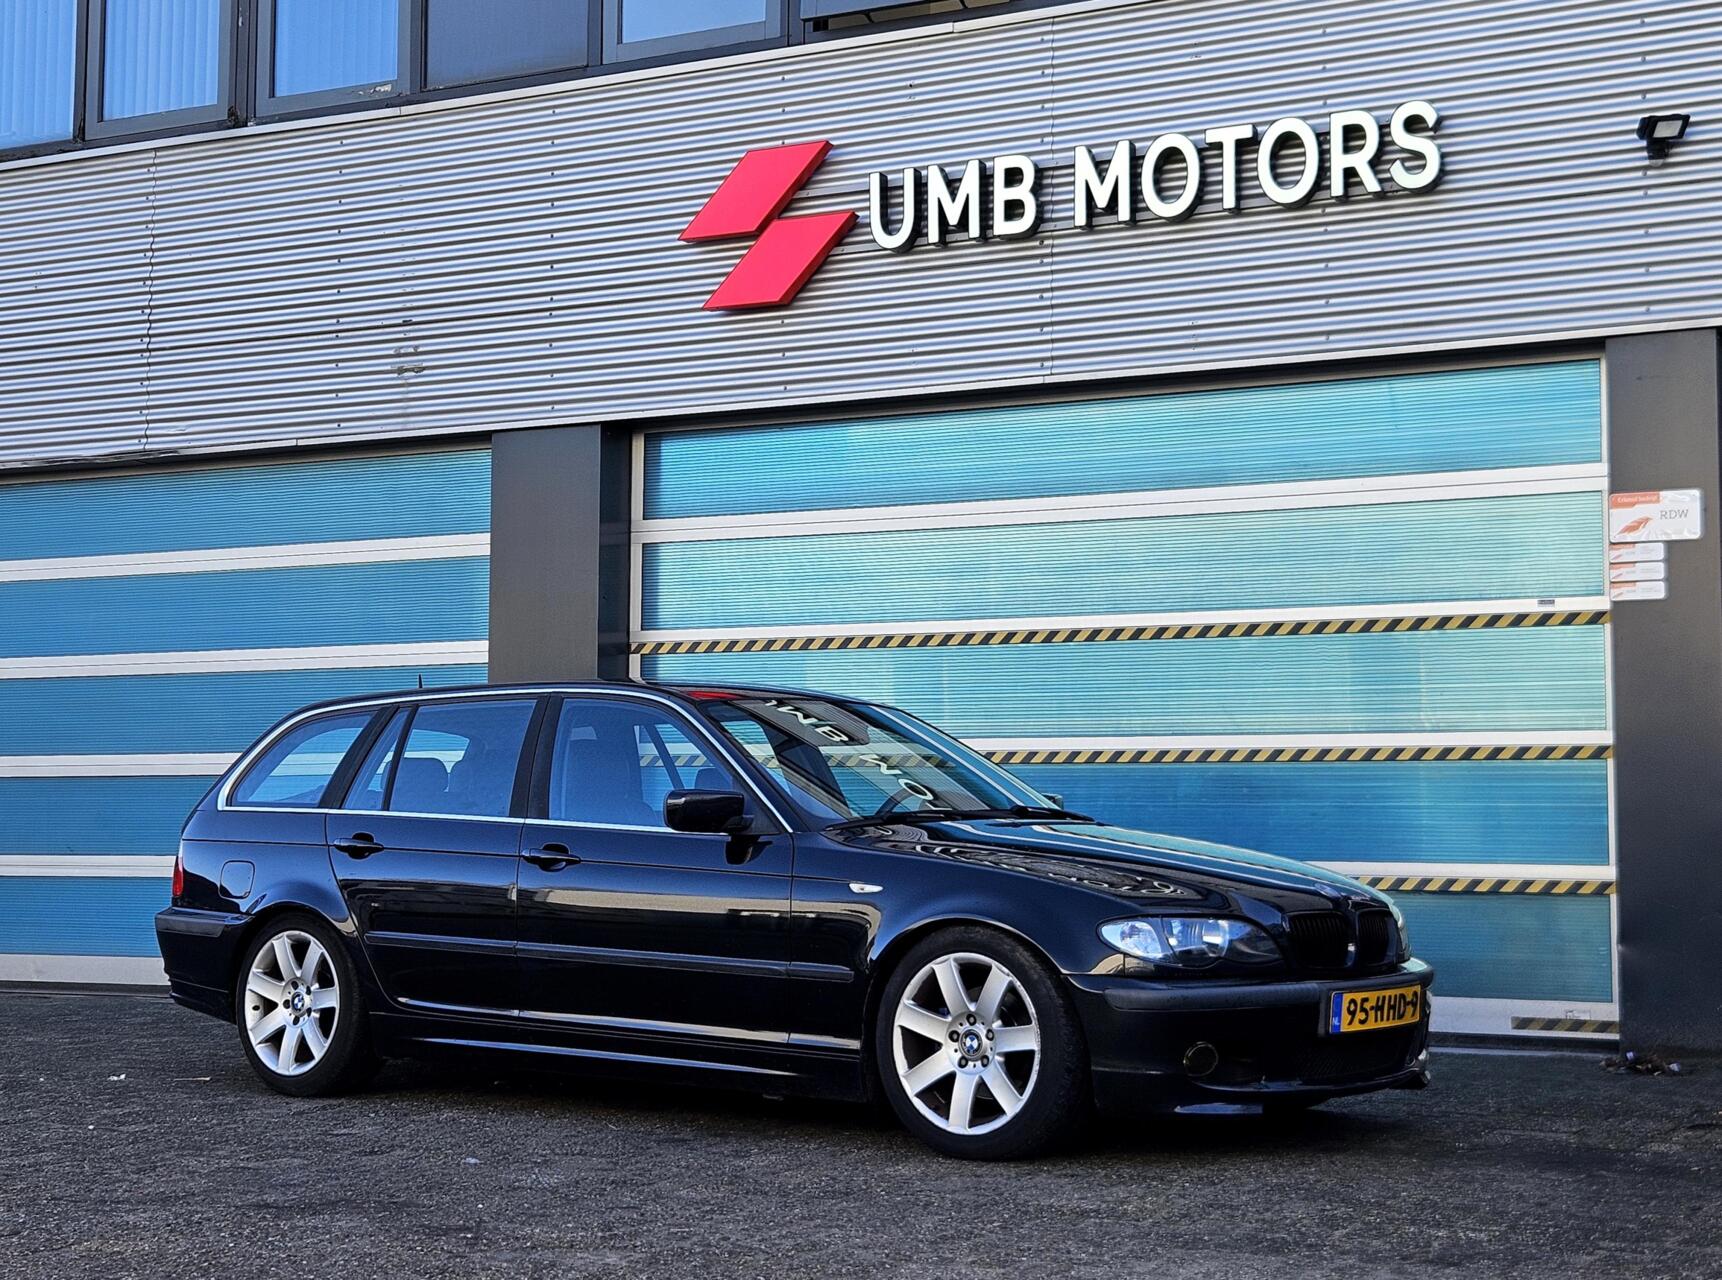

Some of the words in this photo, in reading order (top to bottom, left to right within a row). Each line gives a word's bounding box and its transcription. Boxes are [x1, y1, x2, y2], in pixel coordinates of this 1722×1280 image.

[868, 153, 1040, 252] UMB
[1073, 99, 1443, 229] MOTORS
[1659, 508, 1689, 521] RDW
